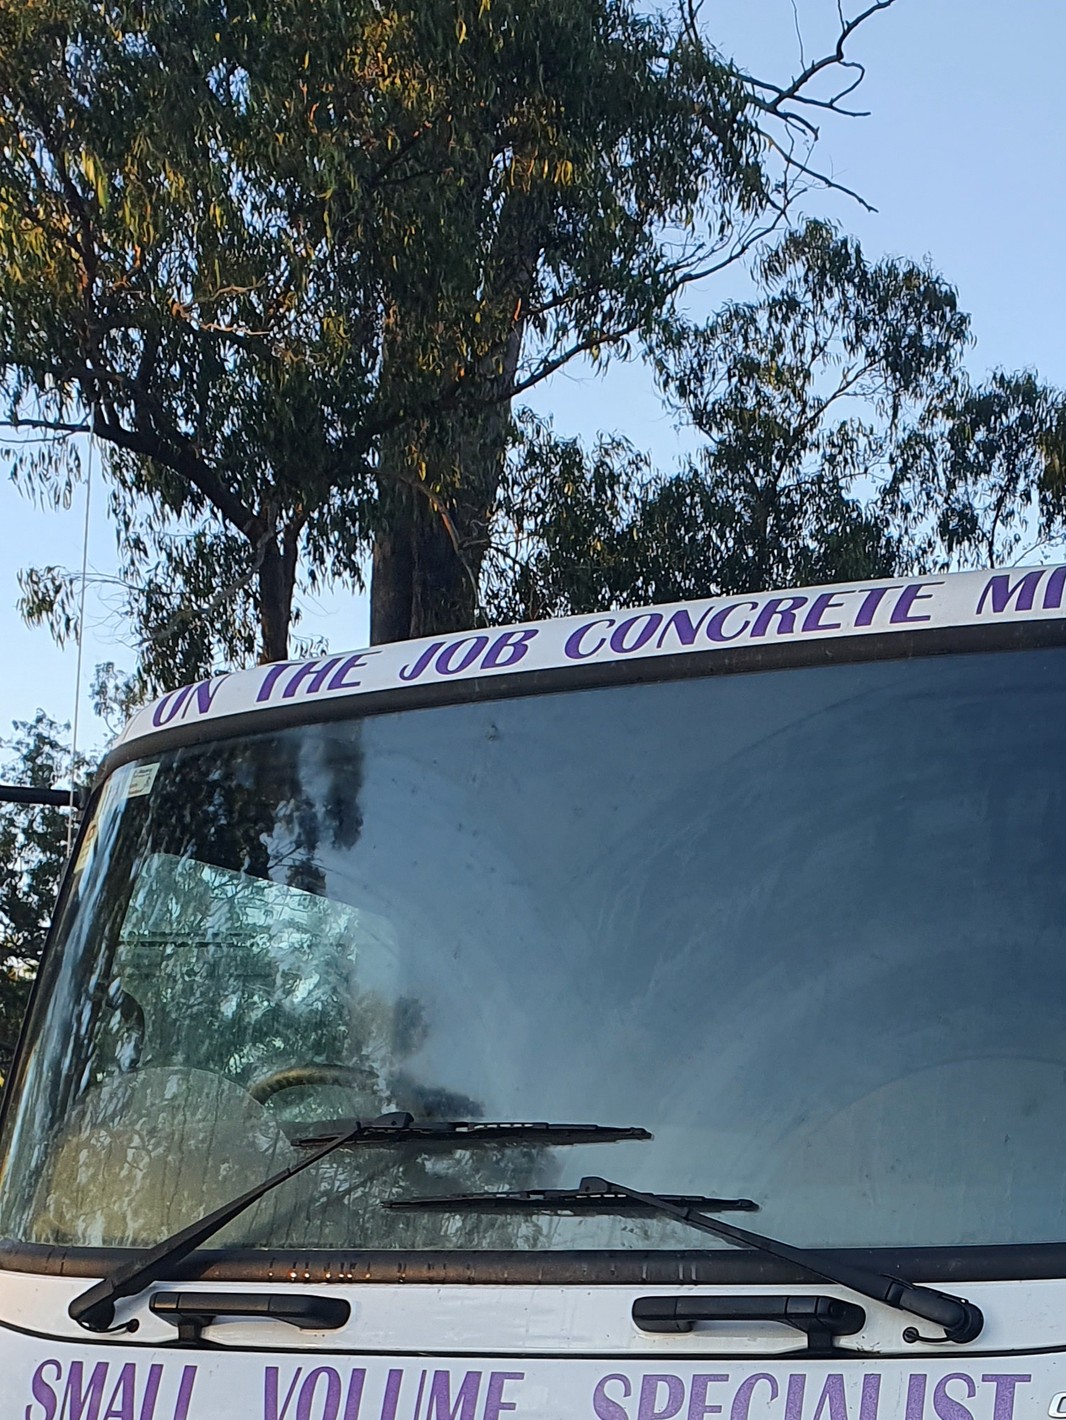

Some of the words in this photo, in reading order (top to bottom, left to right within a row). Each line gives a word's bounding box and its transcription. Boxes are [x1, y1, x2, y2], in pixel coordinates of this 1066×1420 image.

[152, 673, 232, 728] ON
[256, 650, 383, 703] THE
[398, 628, 540, 682] JOB
[563, 580, 945, 660] CONCRETE
